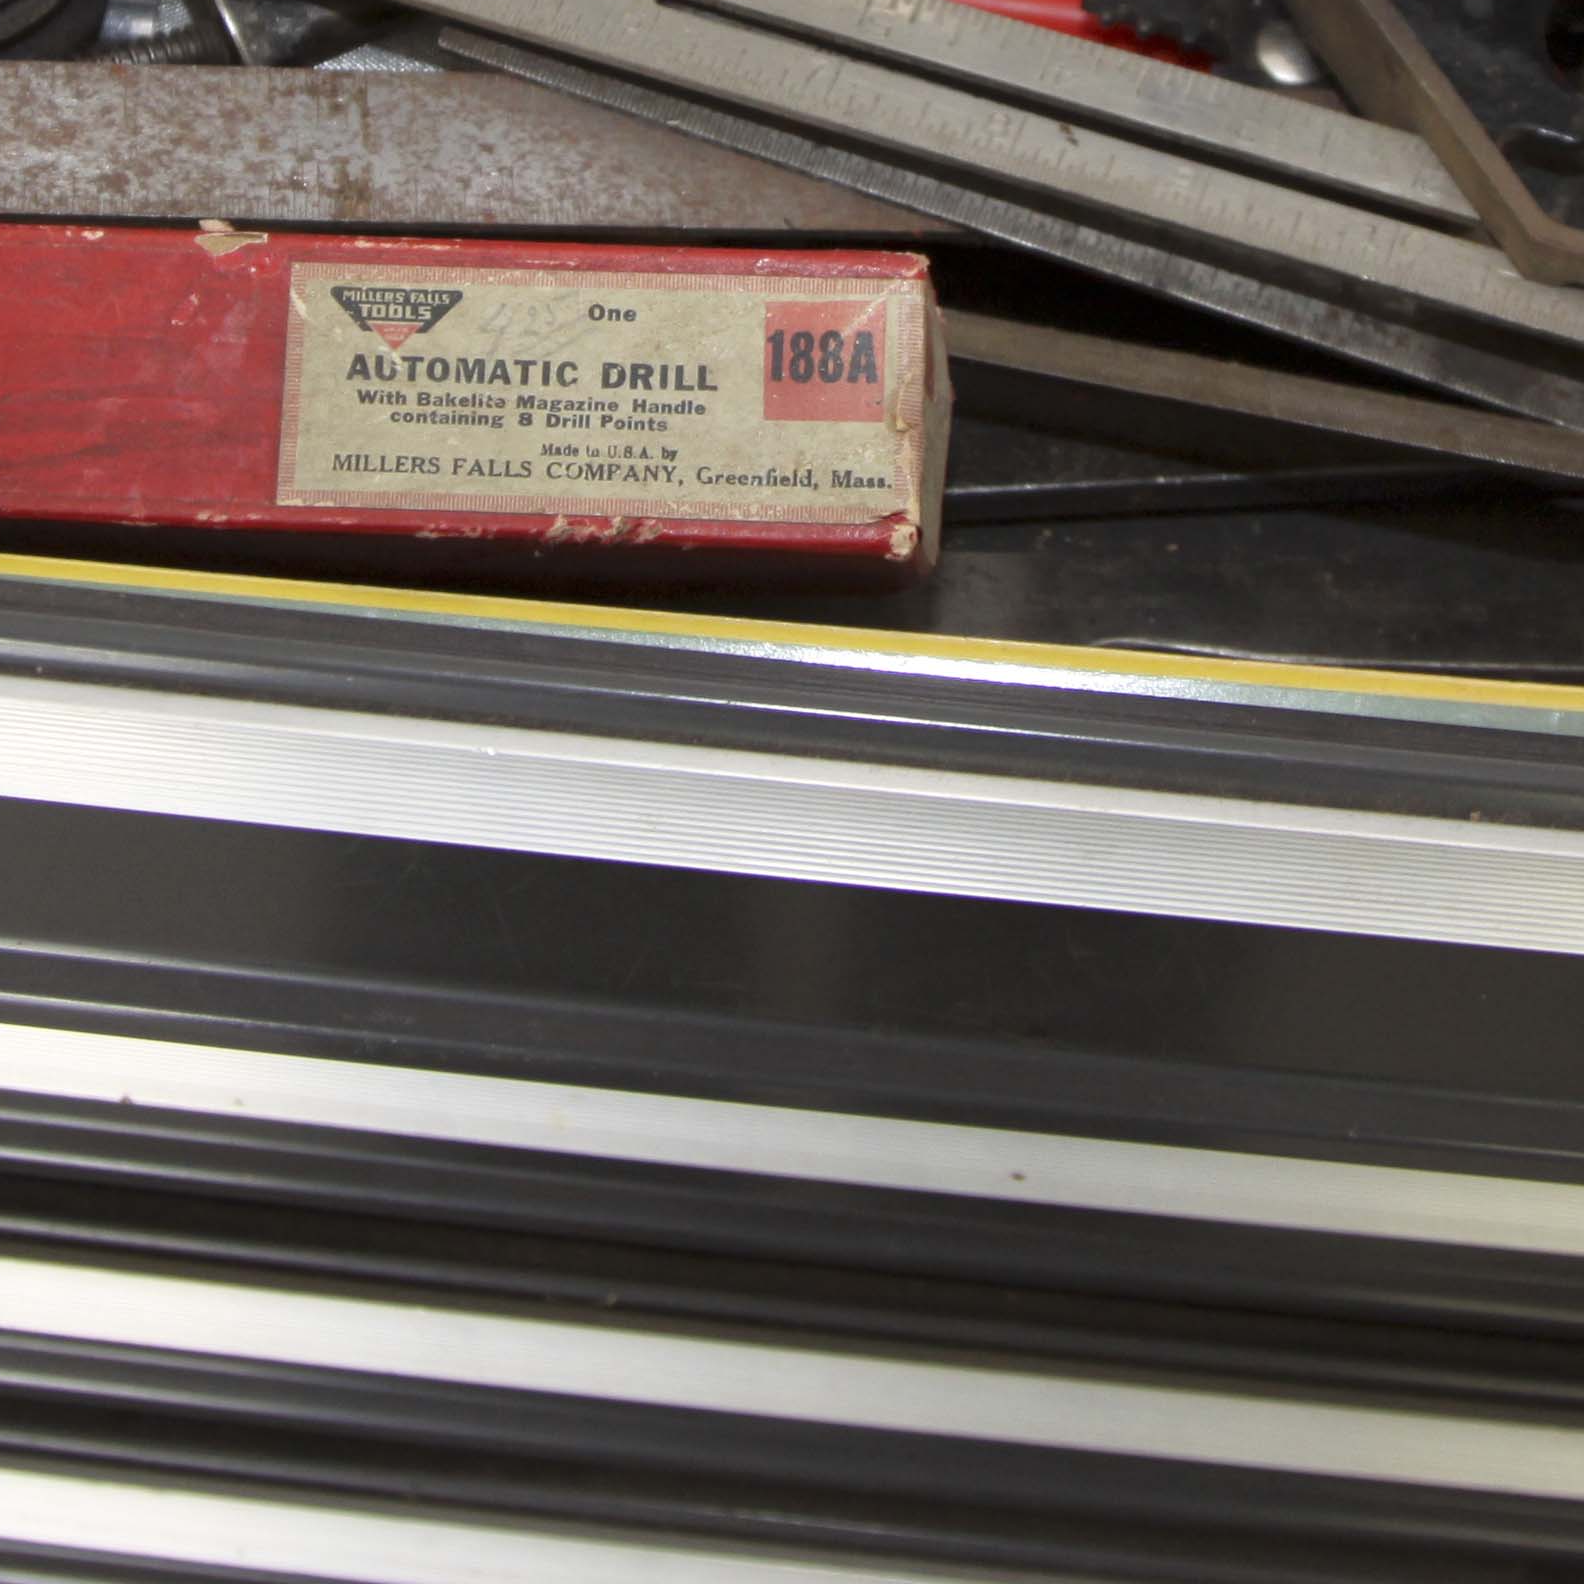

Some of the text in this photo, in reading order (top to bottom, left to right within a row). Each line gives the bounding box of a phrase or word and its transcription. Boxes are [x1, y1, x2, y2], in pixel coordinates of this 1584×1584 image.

[342, 289, 450, 305] MILLERS FALLS
[358, 303, 433, 320] TOOLS
[588, 304, 637, 322] One
[767, 329, 879, 384] 188A
[346, 353, 718, 392] AUTOMATIC DRILL
[357, 389, 706, 415] With Bakelite Magazine Handle
[390, 410, 668, 432] containing 8 Drill Points
[541, 442, 579, 458] Made
[607, 444, 655, 460] U.S.A.
[660, 445, 678, 463] by
[332, 453, 893, 491] MILLERS FALLS COMPANY, Greenfield, Mass.
